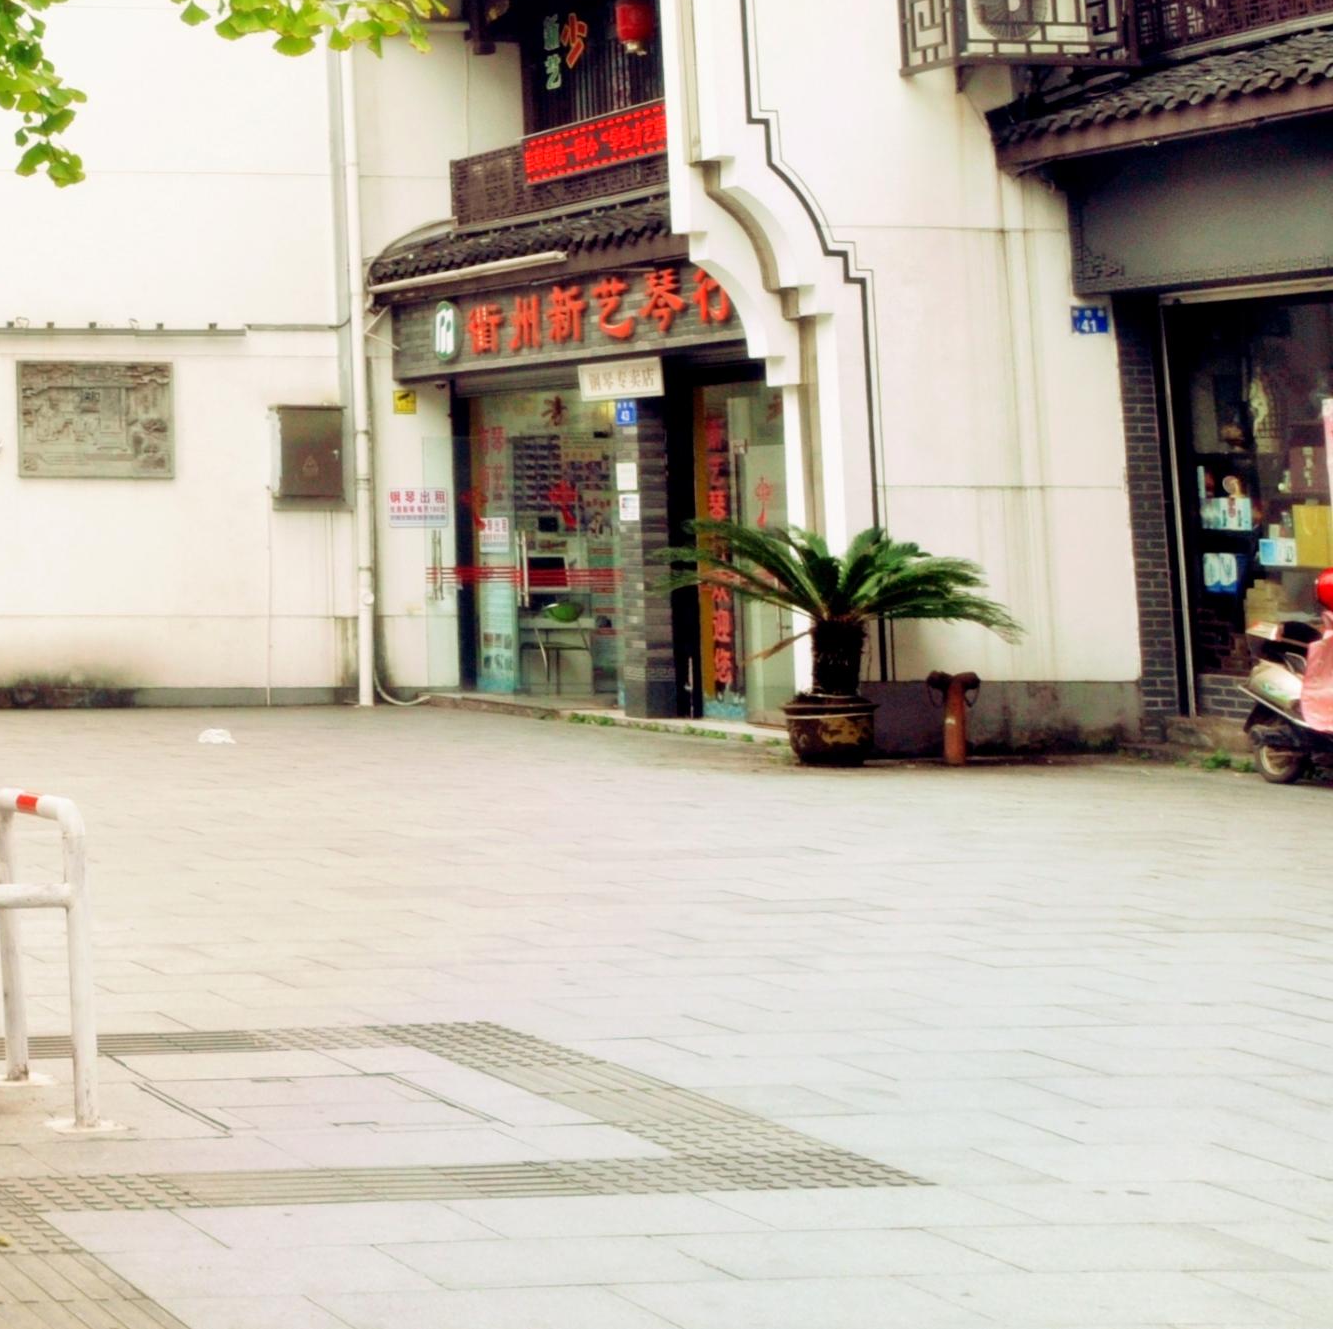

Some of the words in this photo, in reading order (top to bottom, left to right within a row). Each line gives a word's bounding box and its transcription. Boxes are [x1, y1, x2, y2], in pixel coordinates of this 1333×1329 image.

[467, 267, 731, 355] 衢州新艺琴行
